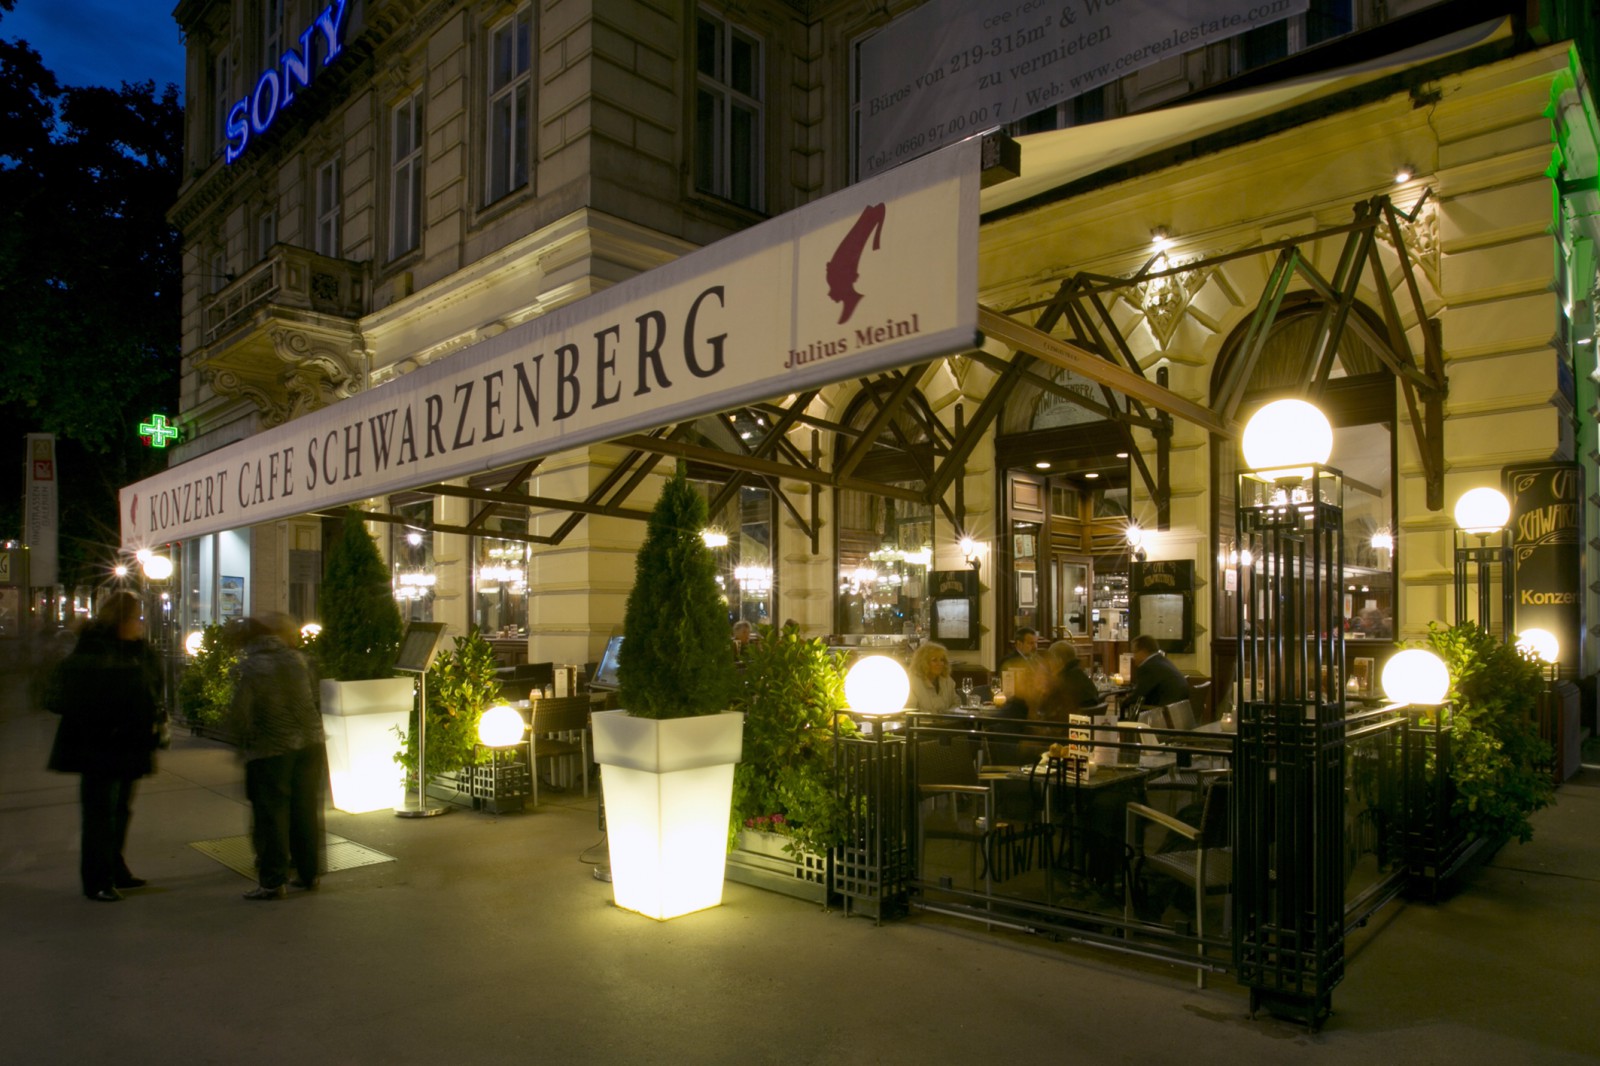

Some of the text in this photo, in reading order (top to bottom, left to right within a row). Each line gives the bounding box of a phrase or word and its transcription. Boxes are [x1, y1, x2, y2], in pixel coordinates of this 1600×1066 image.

[225, 0, 347, 165] SONY
[868, 84, 911, 117] Büros
[915, 67, 945, 89] von
[1059, 6, 1076, 28] &
[895, 133, 924, 157] 0660
[927, 125, 944, 143] 97
[948, 115, 965, 134] 00
[968, 107, 988, 126] 00
[1026, 82, 1064, 106] Web:
[1069, 0, 1291, 91] www.ceerealestate.com
[979, 23, 1111, 90] zu vermieten
[150, 285, 728, 531] KONZERT CAFE SCHWARZENBERG
[784, 313, 920, 369] Julius Meinl
